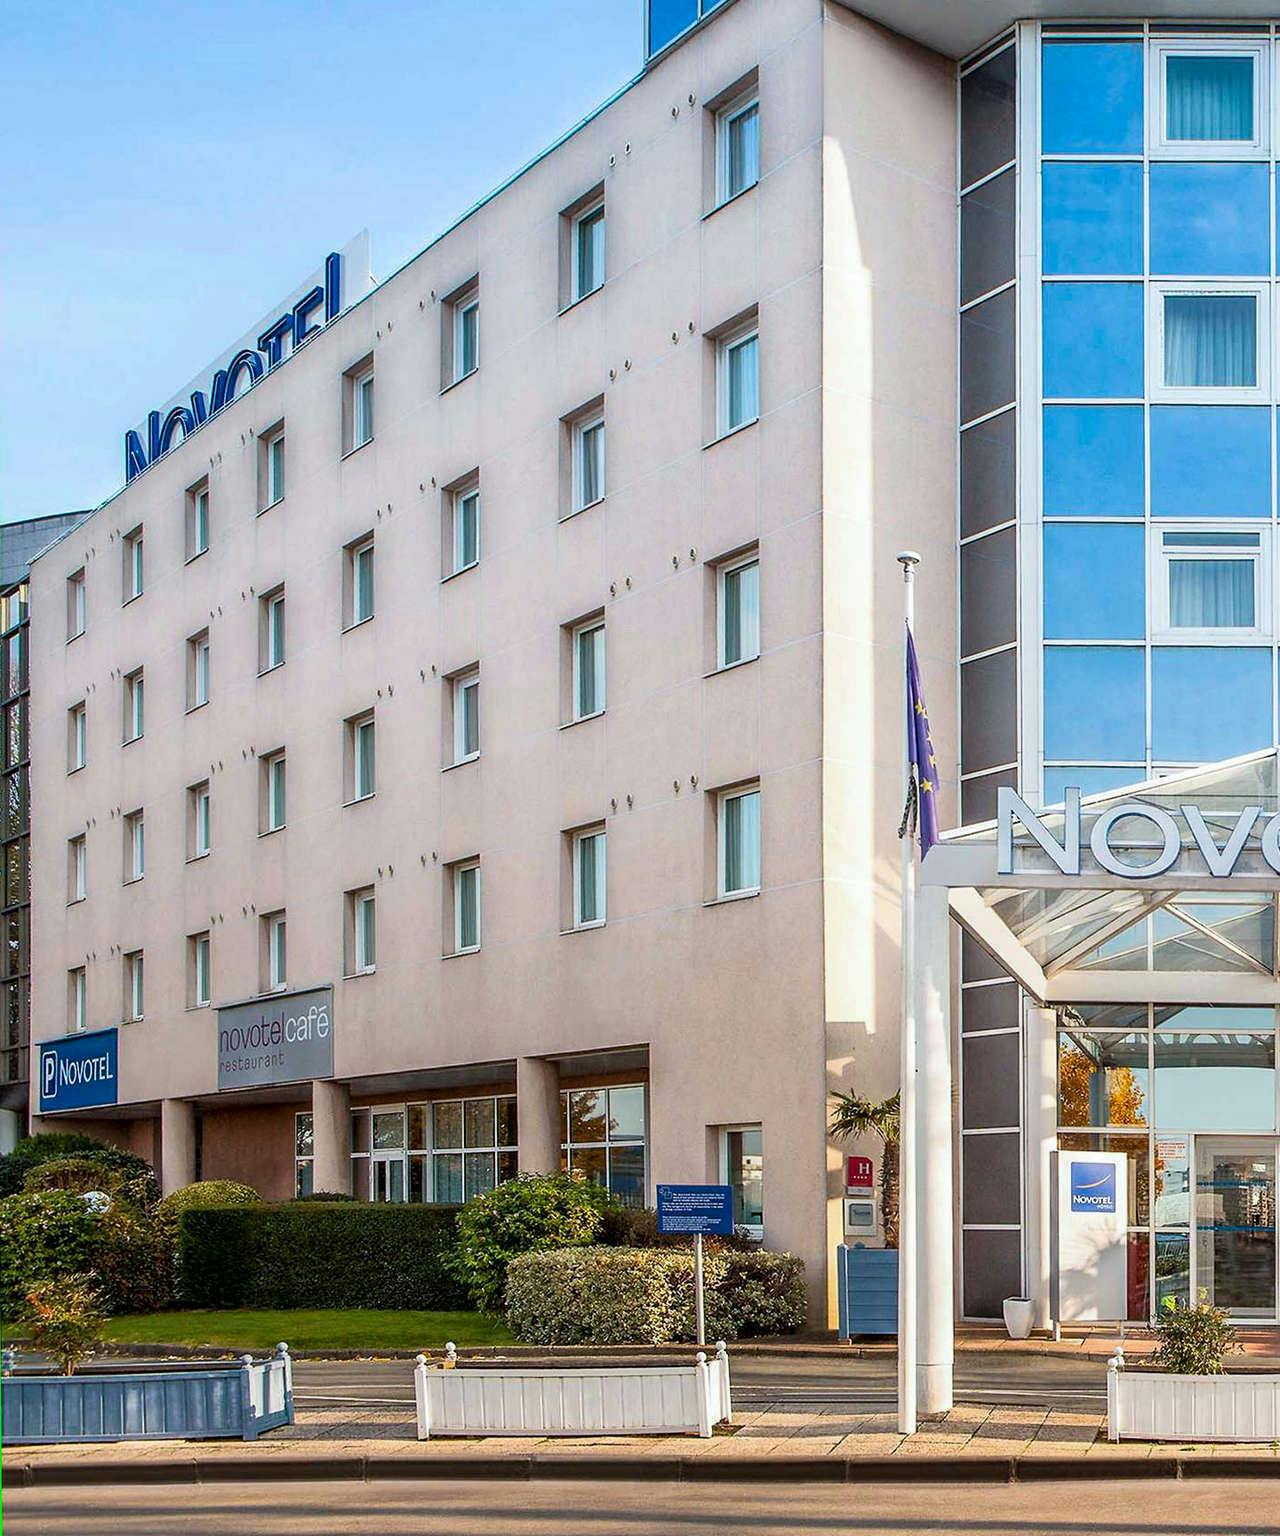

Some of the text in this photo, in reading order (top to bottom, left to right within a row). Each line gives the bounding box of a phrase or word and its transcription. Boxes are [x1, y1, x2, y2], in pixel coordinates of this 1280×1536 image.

[59, 1052, 113, 1086] NOVOTEL
[219, 1053, 284, 1072] restaurant
[859, 1163, 870, 1175] H
[1073, 1195, 1112, 1204] NOVOTEL
